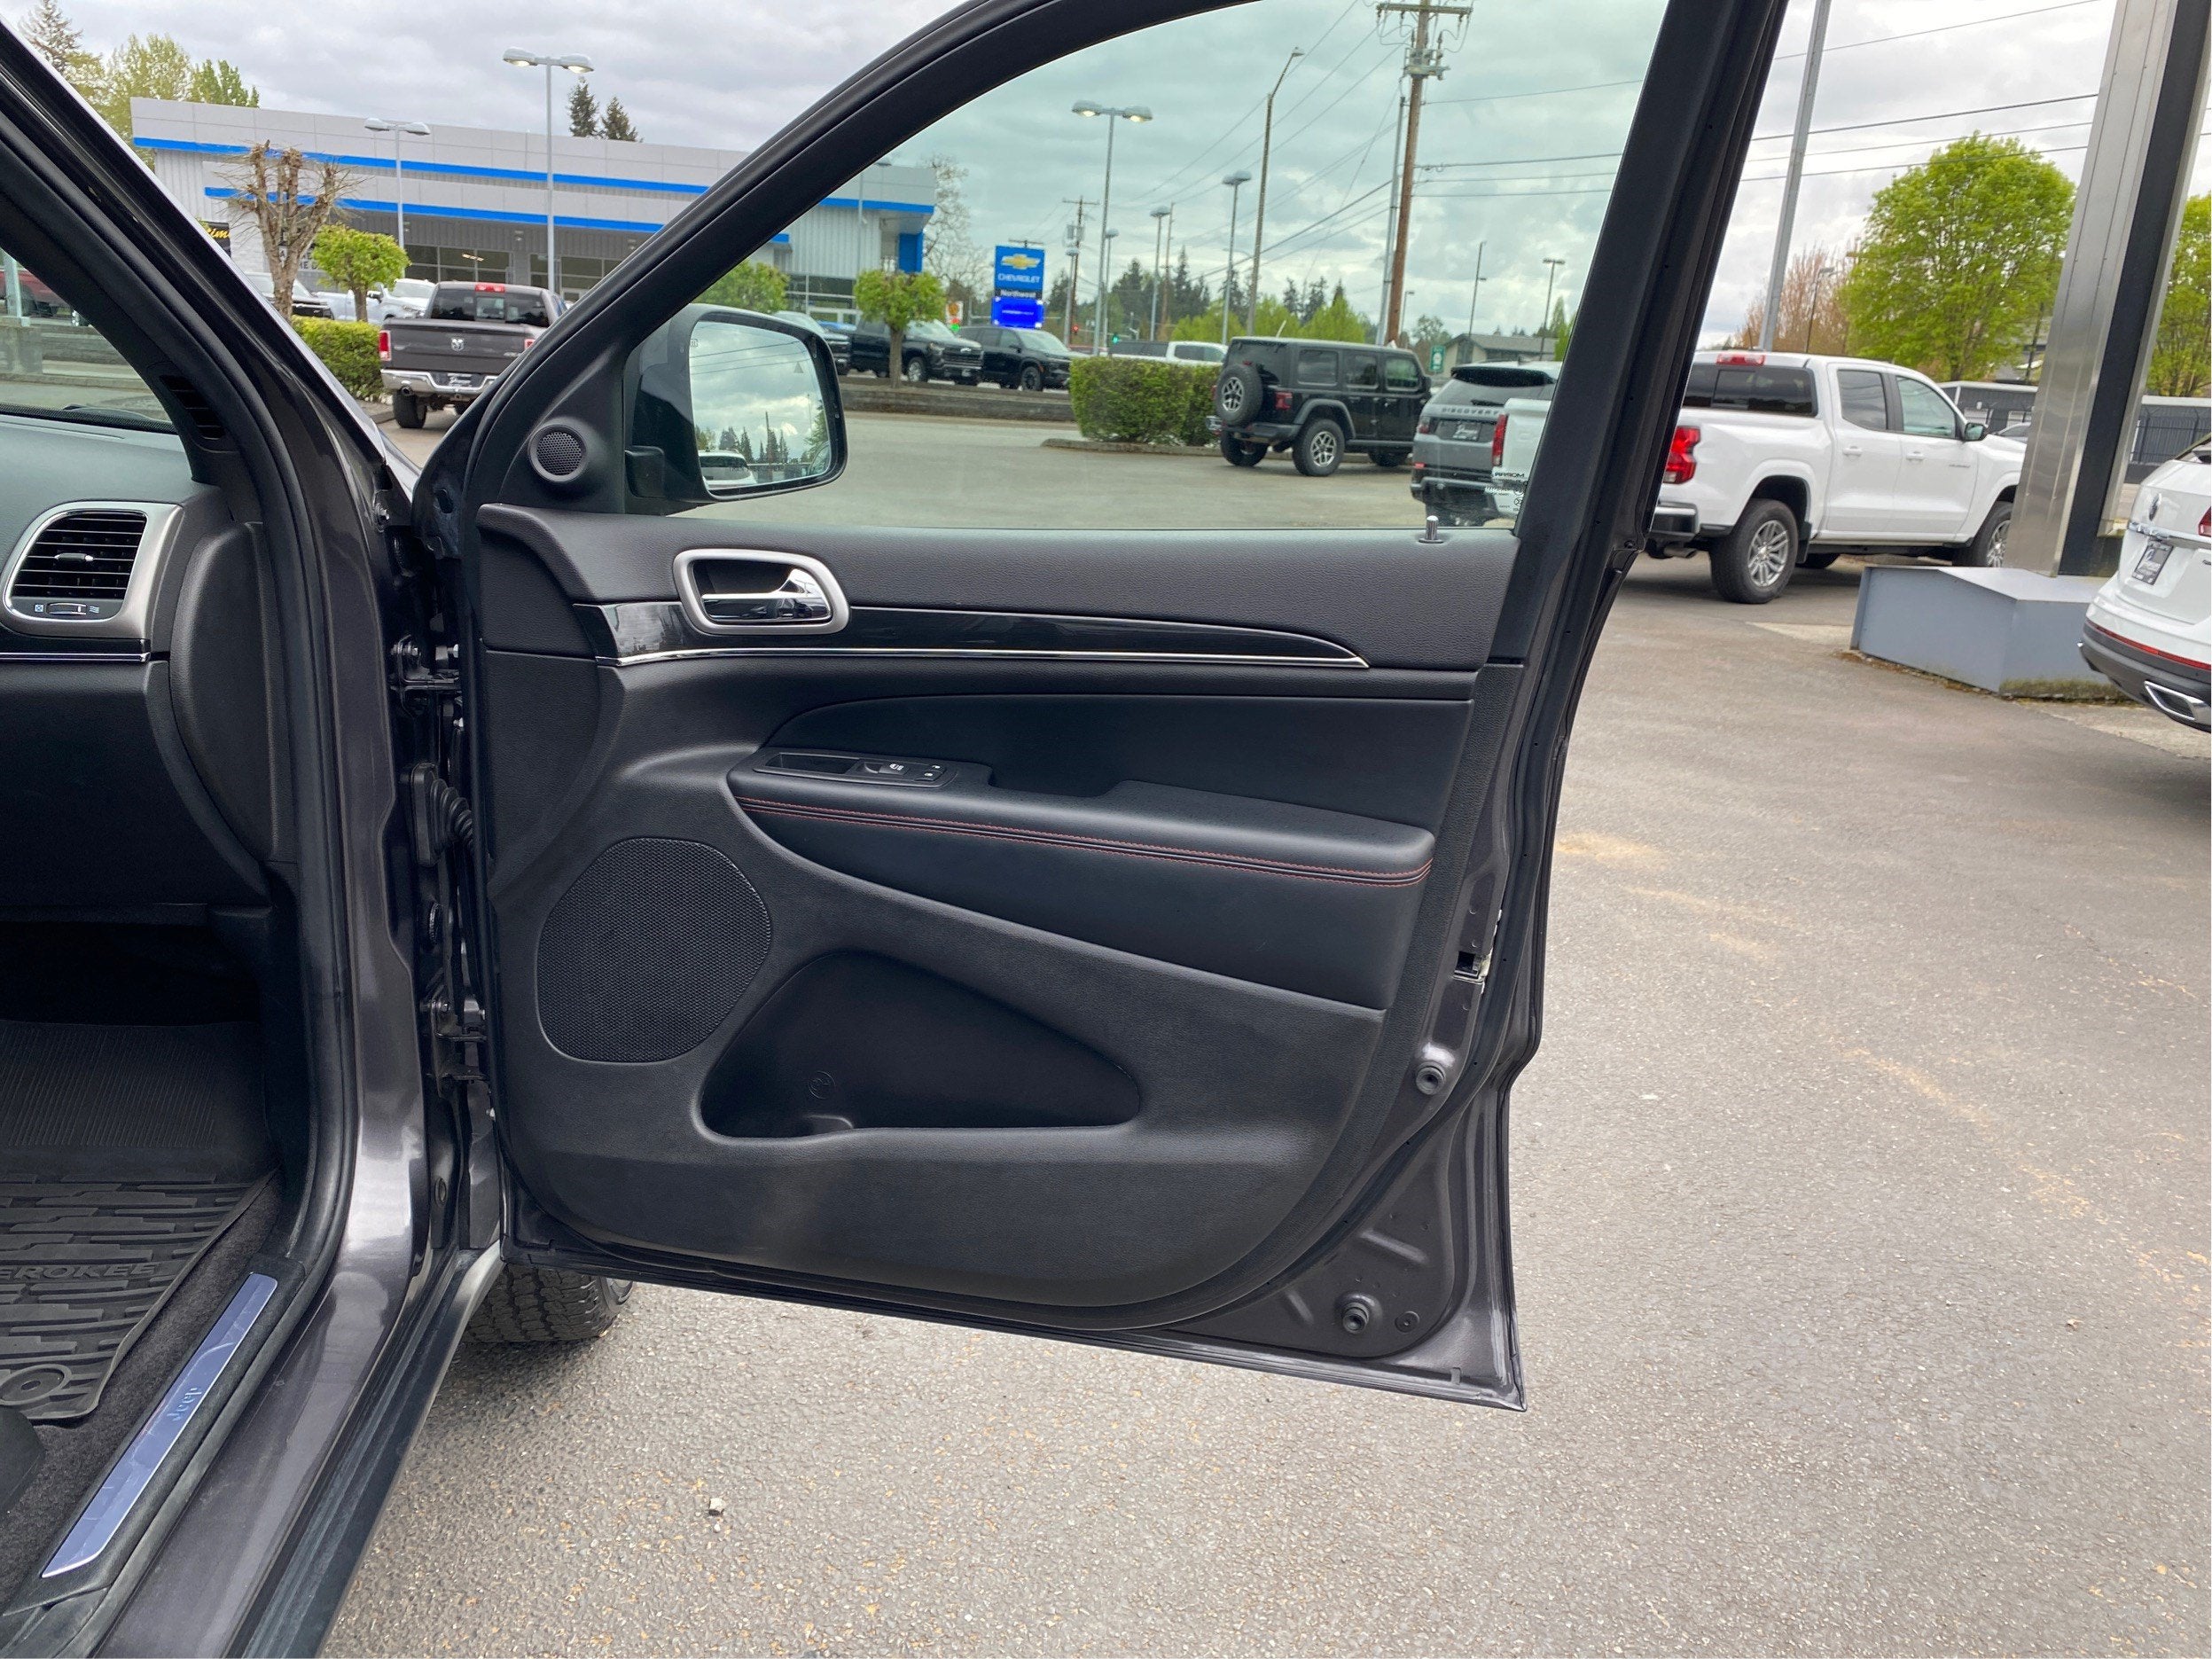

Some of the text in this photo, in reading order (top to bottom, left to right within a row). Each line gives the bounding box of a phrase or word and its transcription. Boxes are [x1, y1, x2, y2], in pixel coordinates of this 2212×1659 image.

[997, 273, 1041, 283] CHEVROLET
[1000, 289, 1036, 298] Northwest
[1442, 407, 1499, 416] DISCOVERY
[167, 1388, 202, 1421] Jeep
